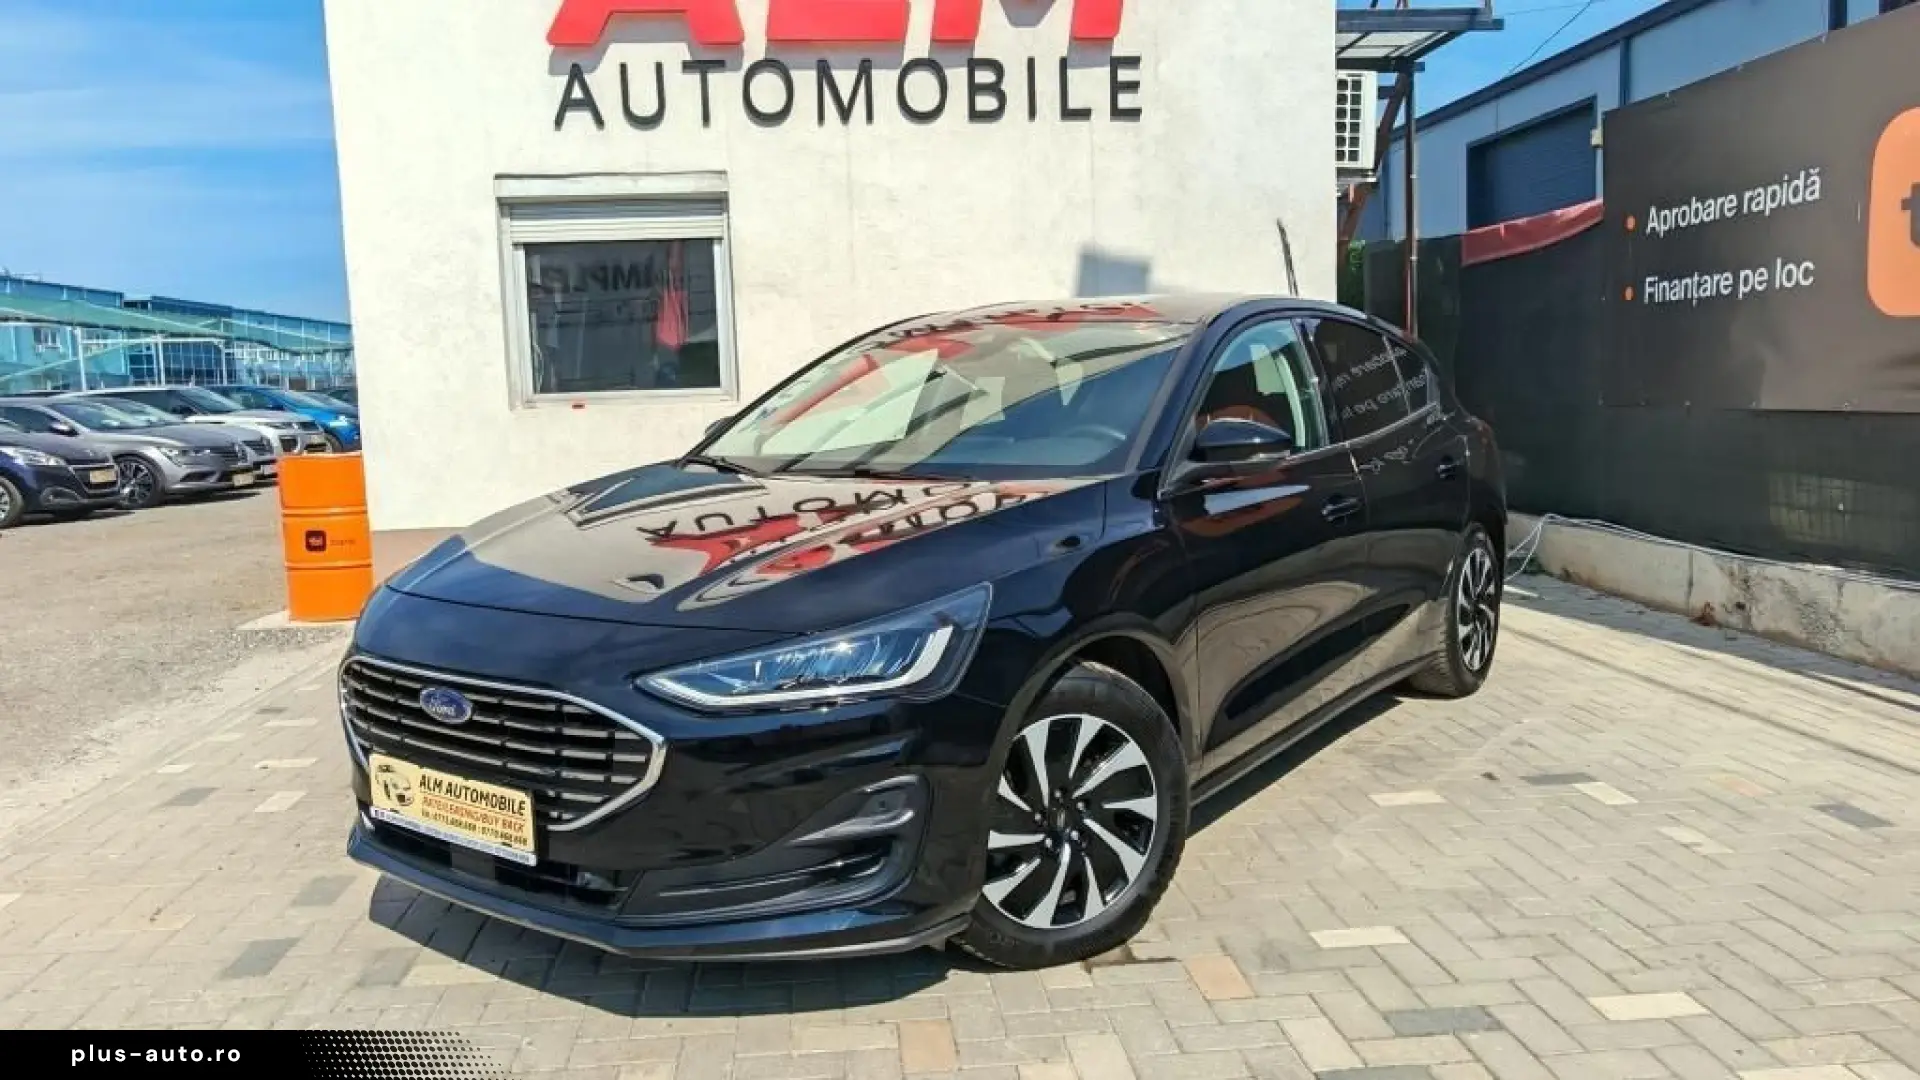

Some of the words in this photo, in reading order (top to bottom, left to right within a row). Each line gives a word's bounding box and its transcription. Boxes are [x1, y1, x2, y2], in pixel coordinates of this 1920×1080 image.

[553, 55, 1143, 130] AUTOMOBILE
[1646, 193, 1738, 238] Aprobare
[1742, 167, 1822, 217] rapidă
[1643, 273, 1734, 308] Finanțare
[1738, 266, 1769, 300] pe
[1775, 256, 1815, 290] loc
[419, 774, 443, 793] ALM
[444, 782, 526, 816] AUTOMOBILE
